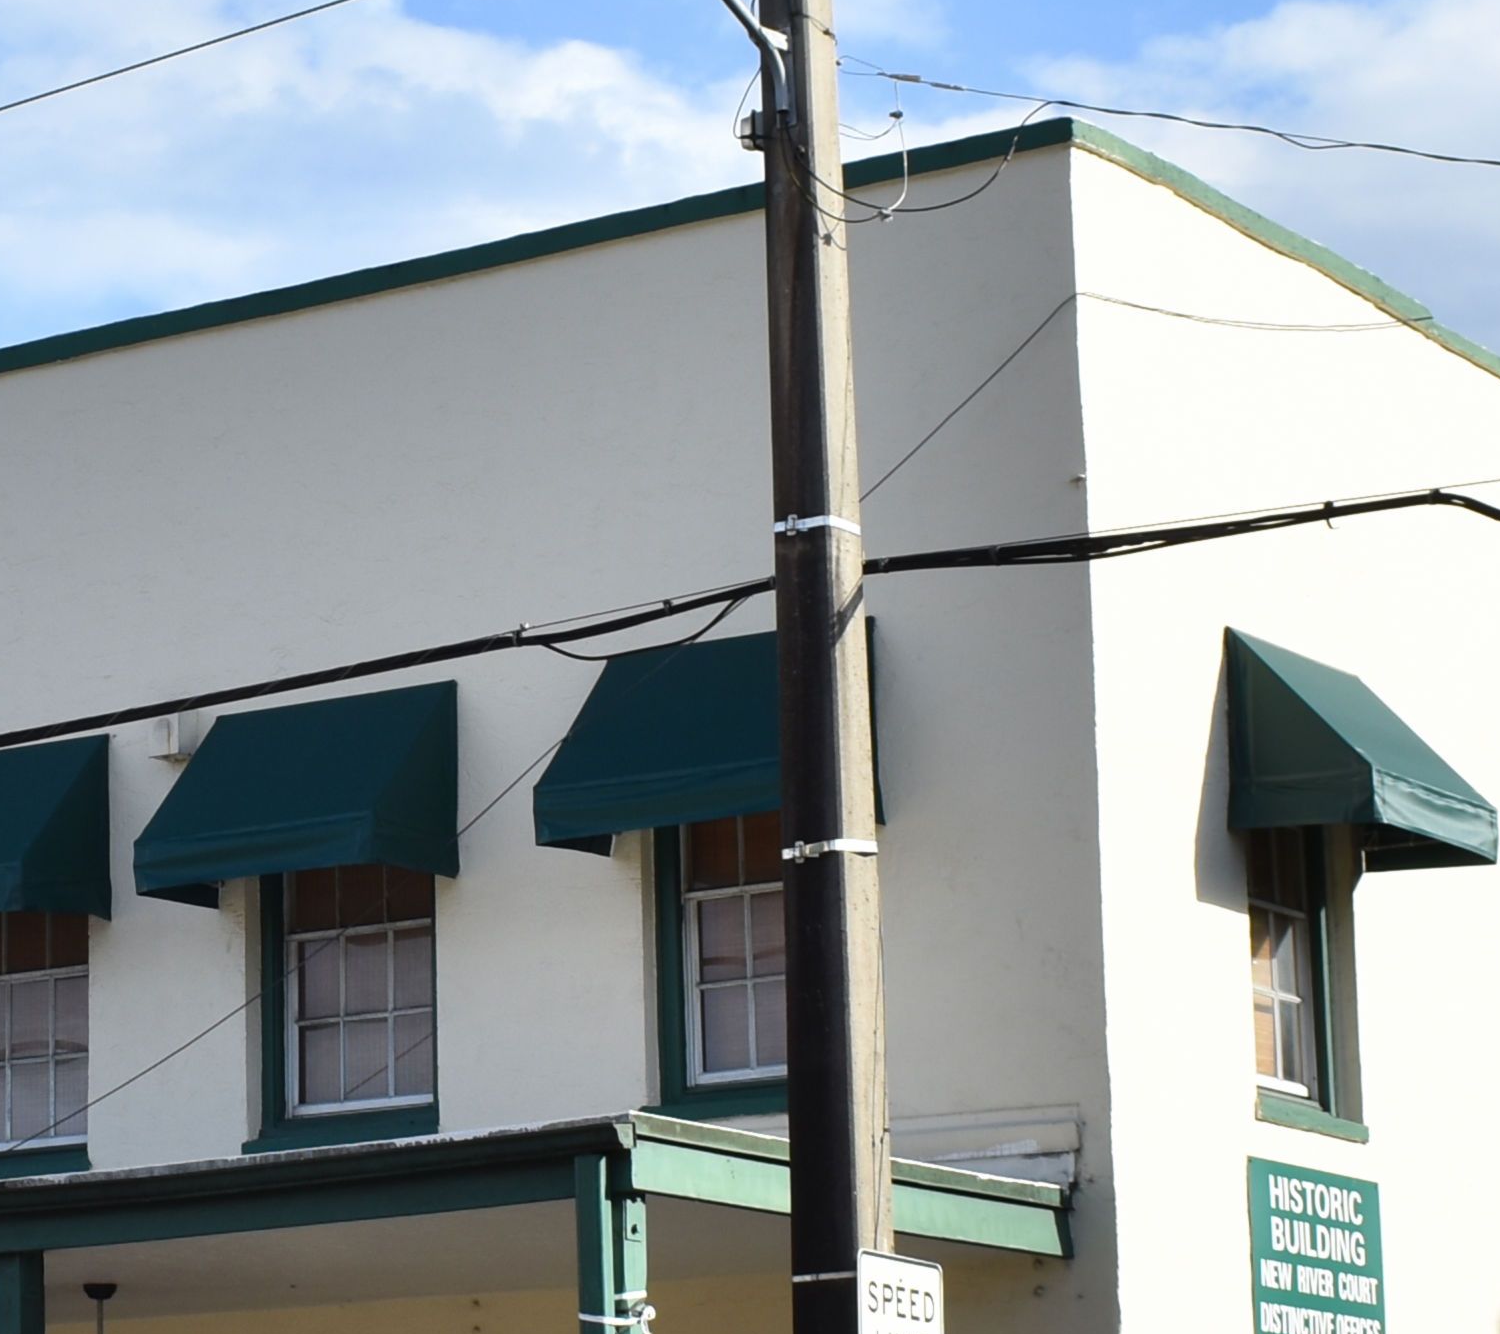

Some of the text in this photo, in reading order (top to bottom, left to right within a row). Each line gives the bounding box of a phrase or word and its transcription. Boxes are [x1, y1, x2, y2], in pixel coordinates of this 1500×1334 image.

[1268, 1173, 1363, 1226] HISTORIC
[1270, 1215, 1366, 1267] BUILDING
[868, 1280, 936, 1323] SPEED
[1260, 1258, 1378, 1305] NEW RIVER COURT
